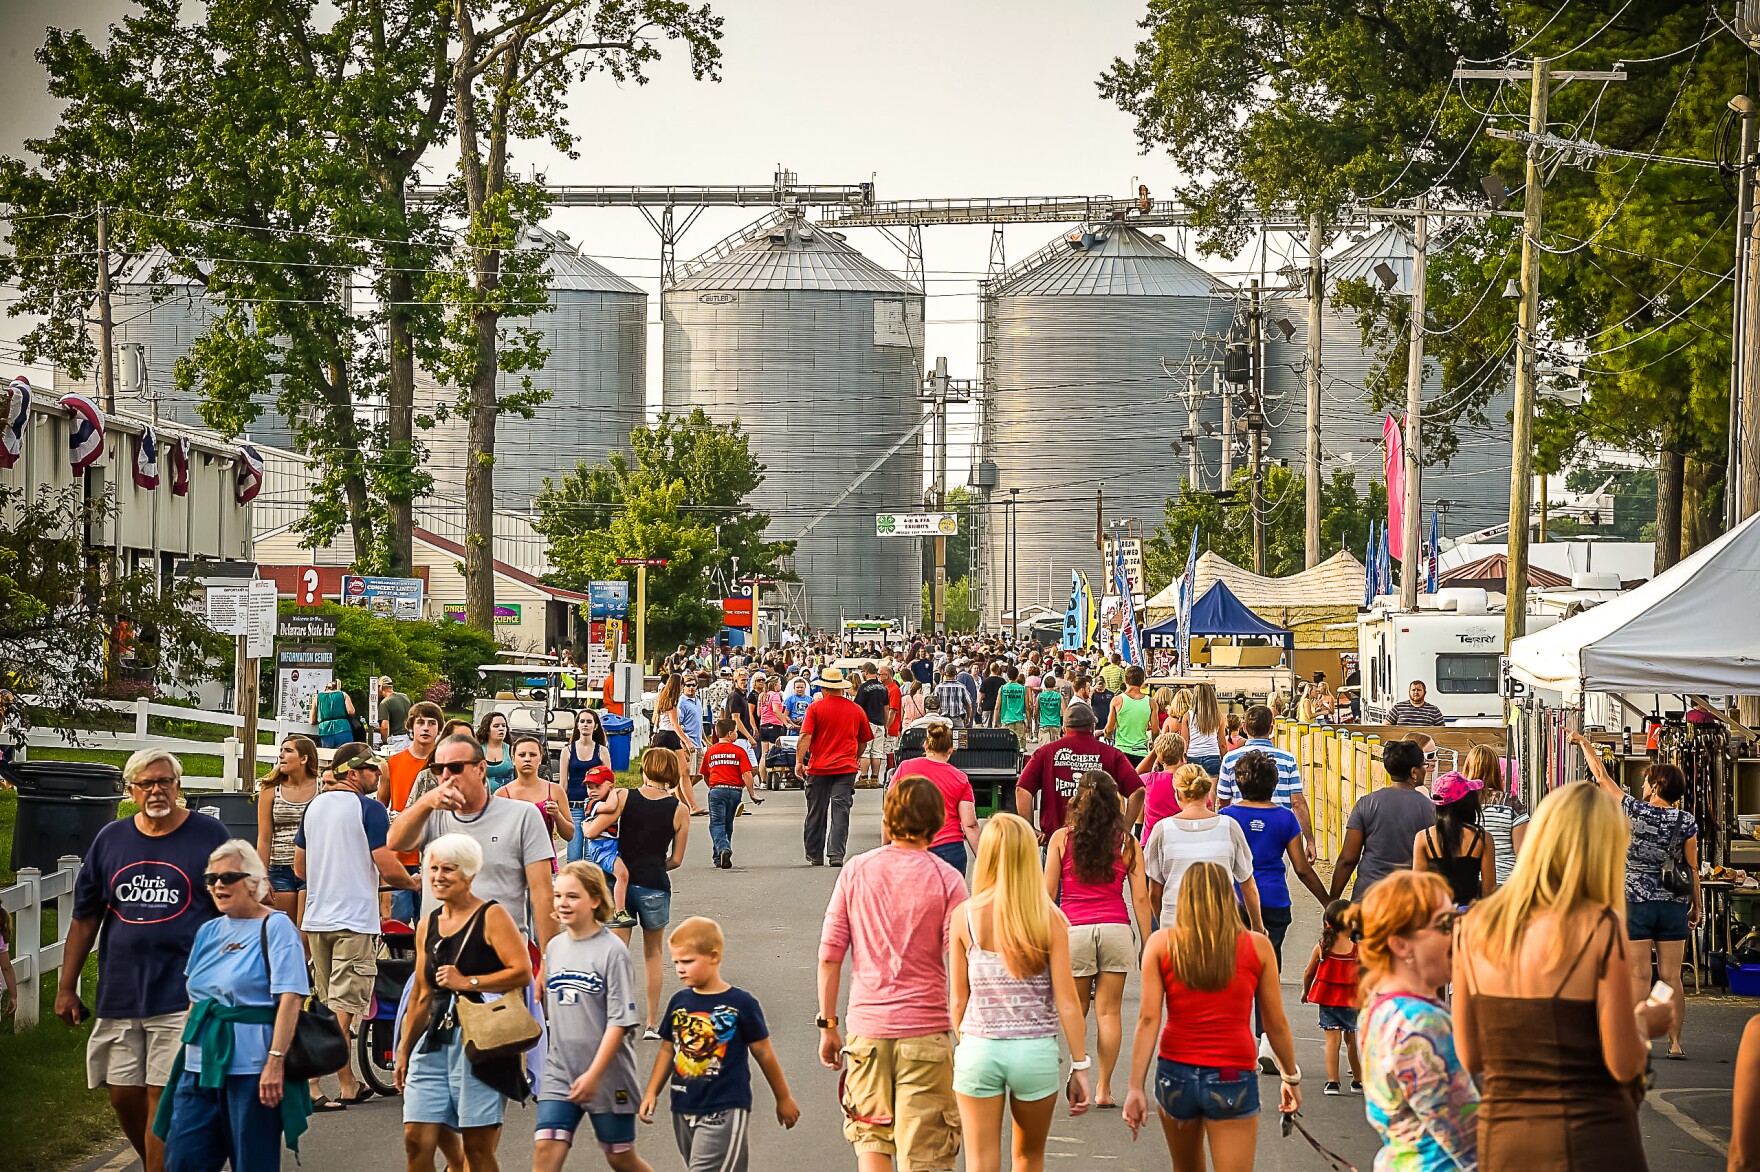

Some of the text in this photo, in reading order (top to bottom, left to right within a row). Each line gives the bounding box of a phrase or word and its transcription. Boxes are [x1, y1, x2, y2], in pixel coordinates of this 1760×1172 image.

[280, 622, 336, 636] Delaware State Fair
[314, 652, 332, 663] CENTER
[1060, 752, 1100, 762] ARCHERY
[1054, 760, 1103, 768] DISCOUNTERS
[132, 874, 166, 888] Chris
[115, 882, 180, 904] Coons
